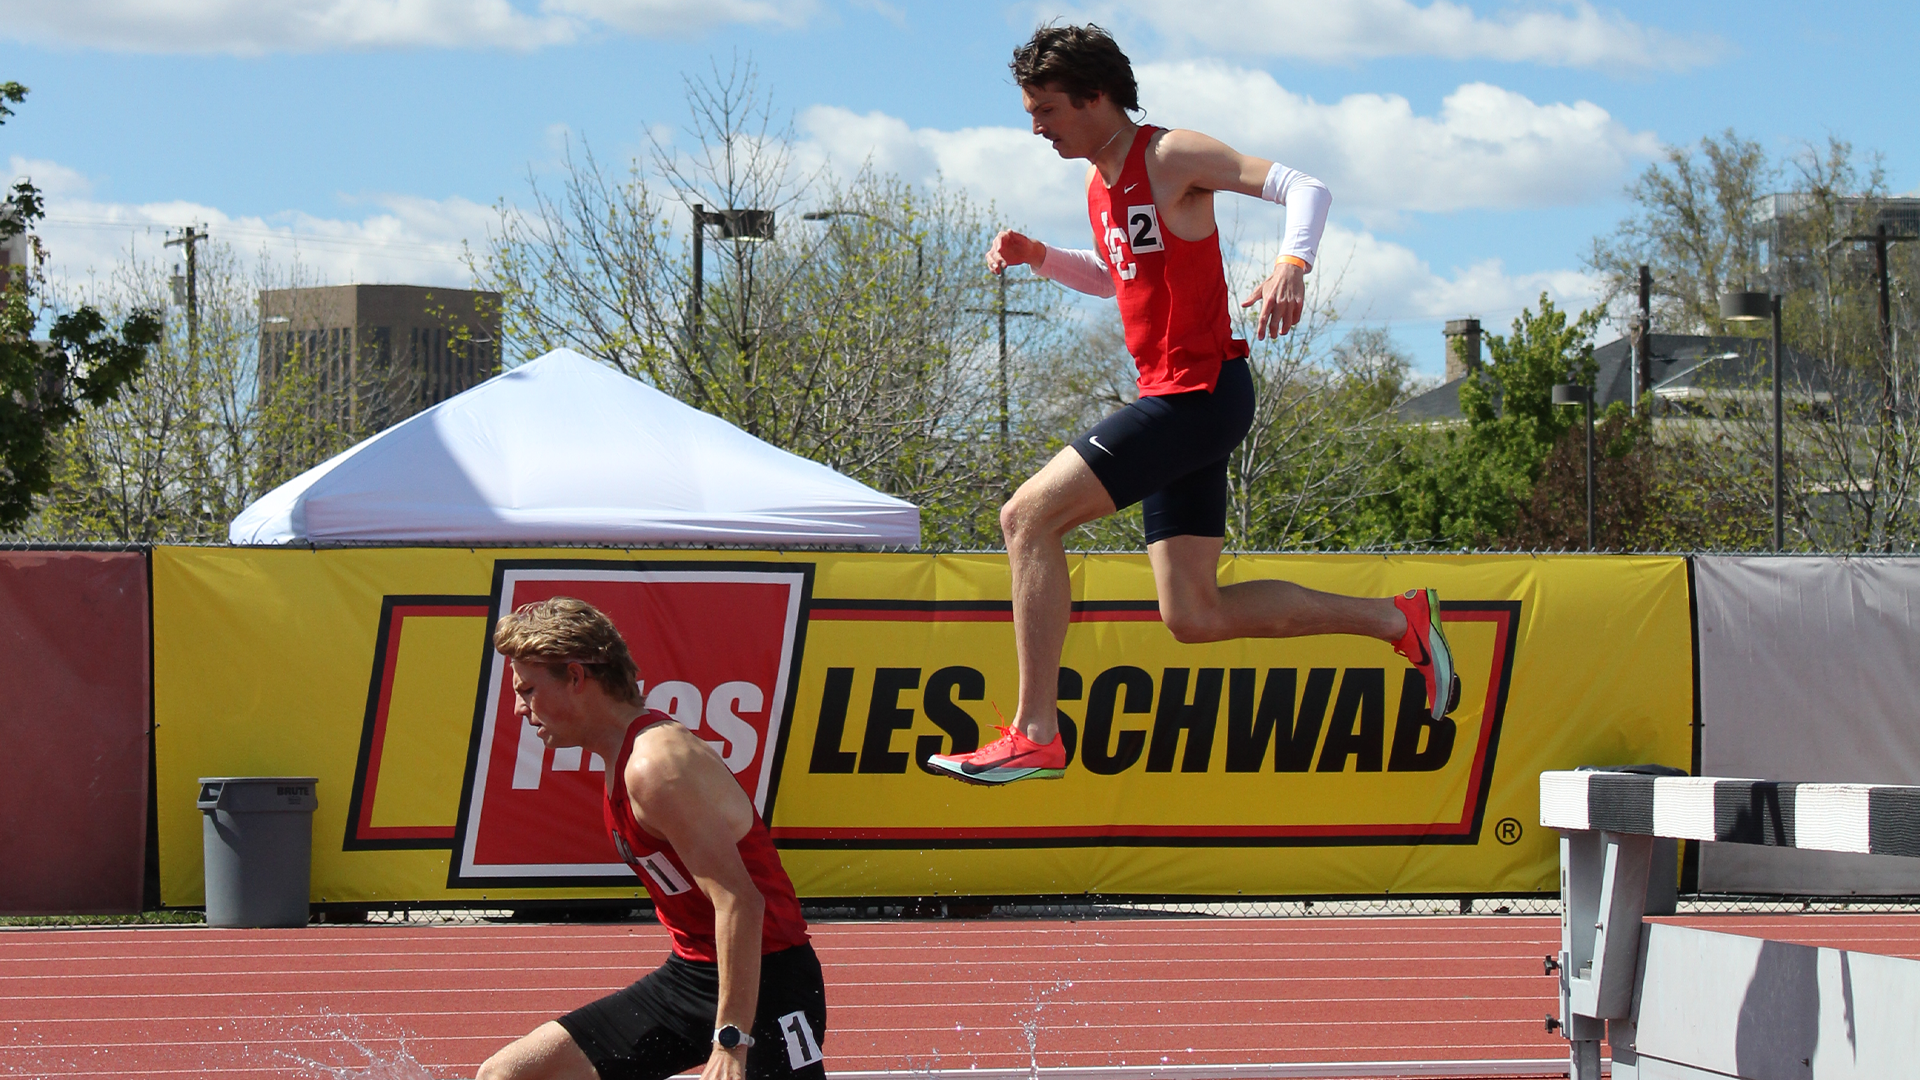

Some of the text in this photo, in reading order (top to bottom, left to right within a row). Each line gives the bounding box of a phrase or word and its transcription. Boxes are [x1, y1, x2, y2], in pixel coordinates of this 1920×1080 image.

[1130, 213, 1157, 247] 2
[808, 666, 985, 776] LES
[277, 786, 309, 796] BRUTE
[646, 859, 679, 892] 1
[787, 1015, 812, 1062] 1
